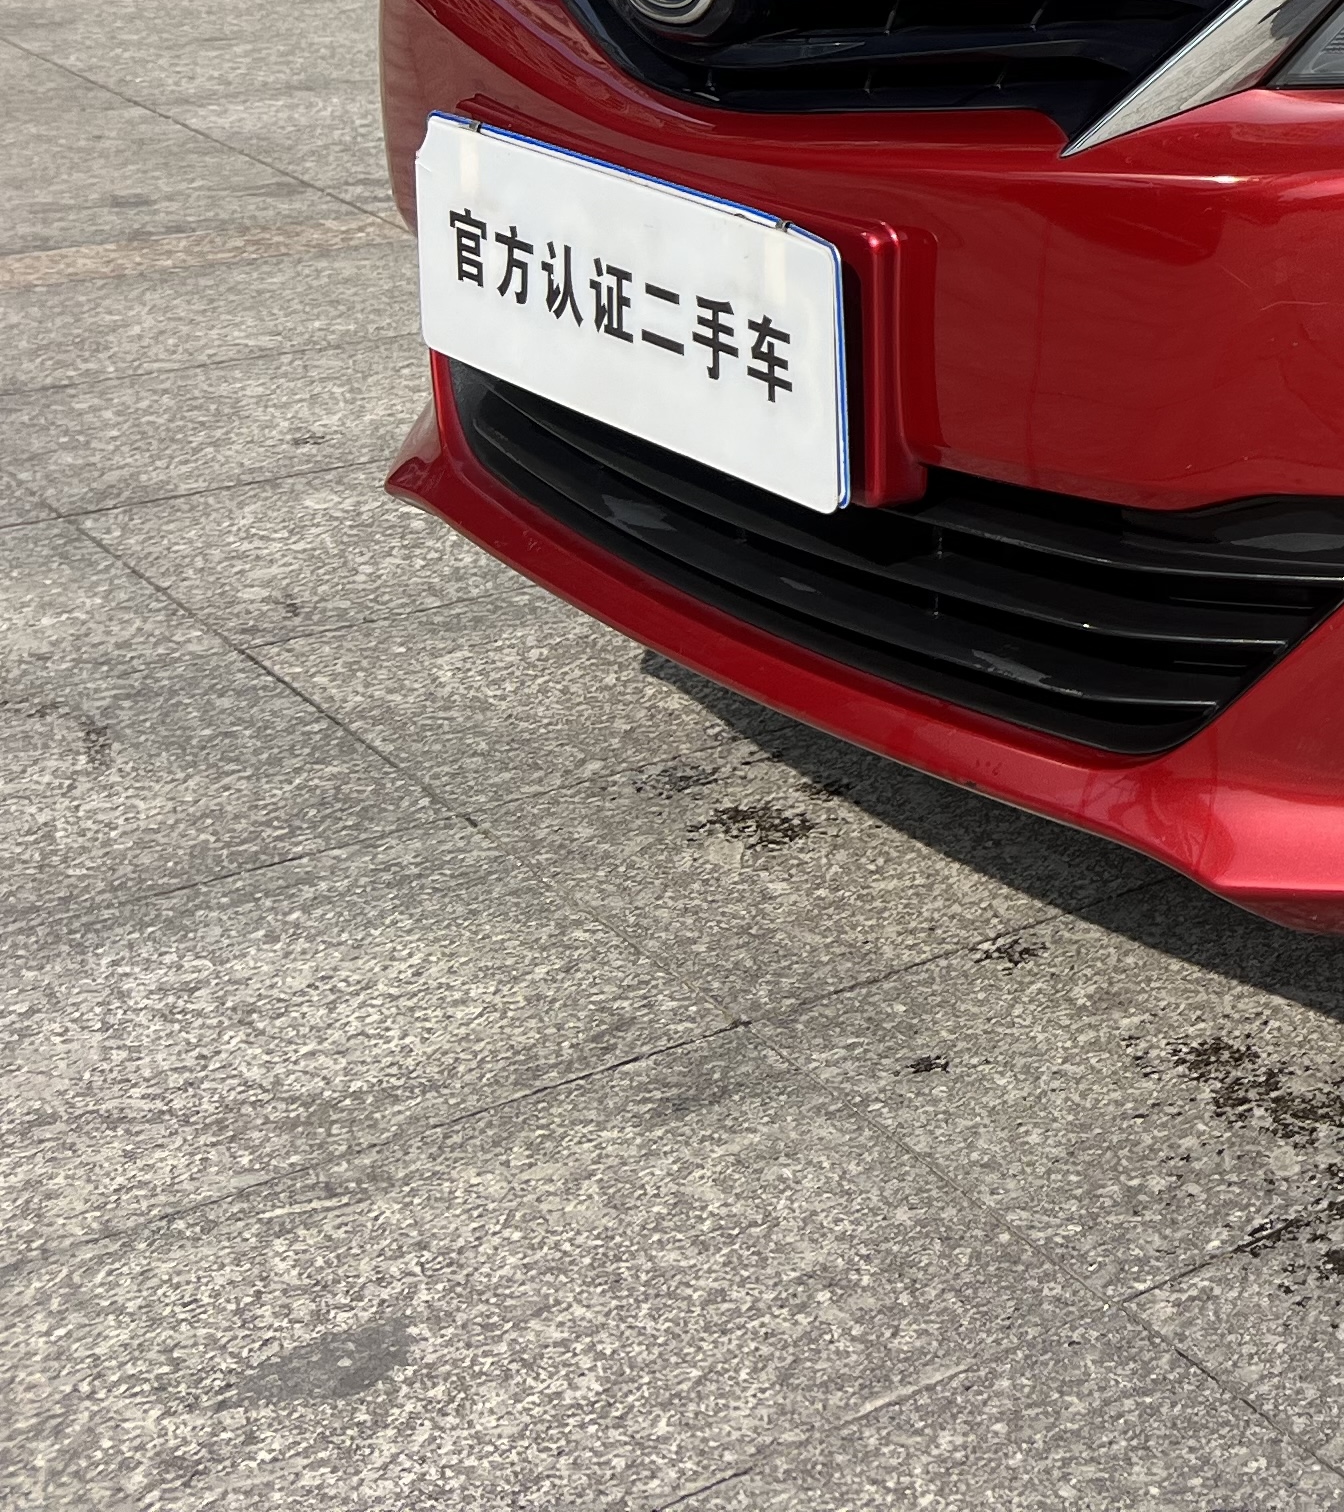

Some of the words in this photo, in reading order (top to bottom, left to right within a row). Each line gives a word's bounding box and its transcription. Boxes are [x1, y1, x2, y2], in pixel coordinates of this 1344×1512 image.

[449, 208, 793, 403] 官方认证二手车
